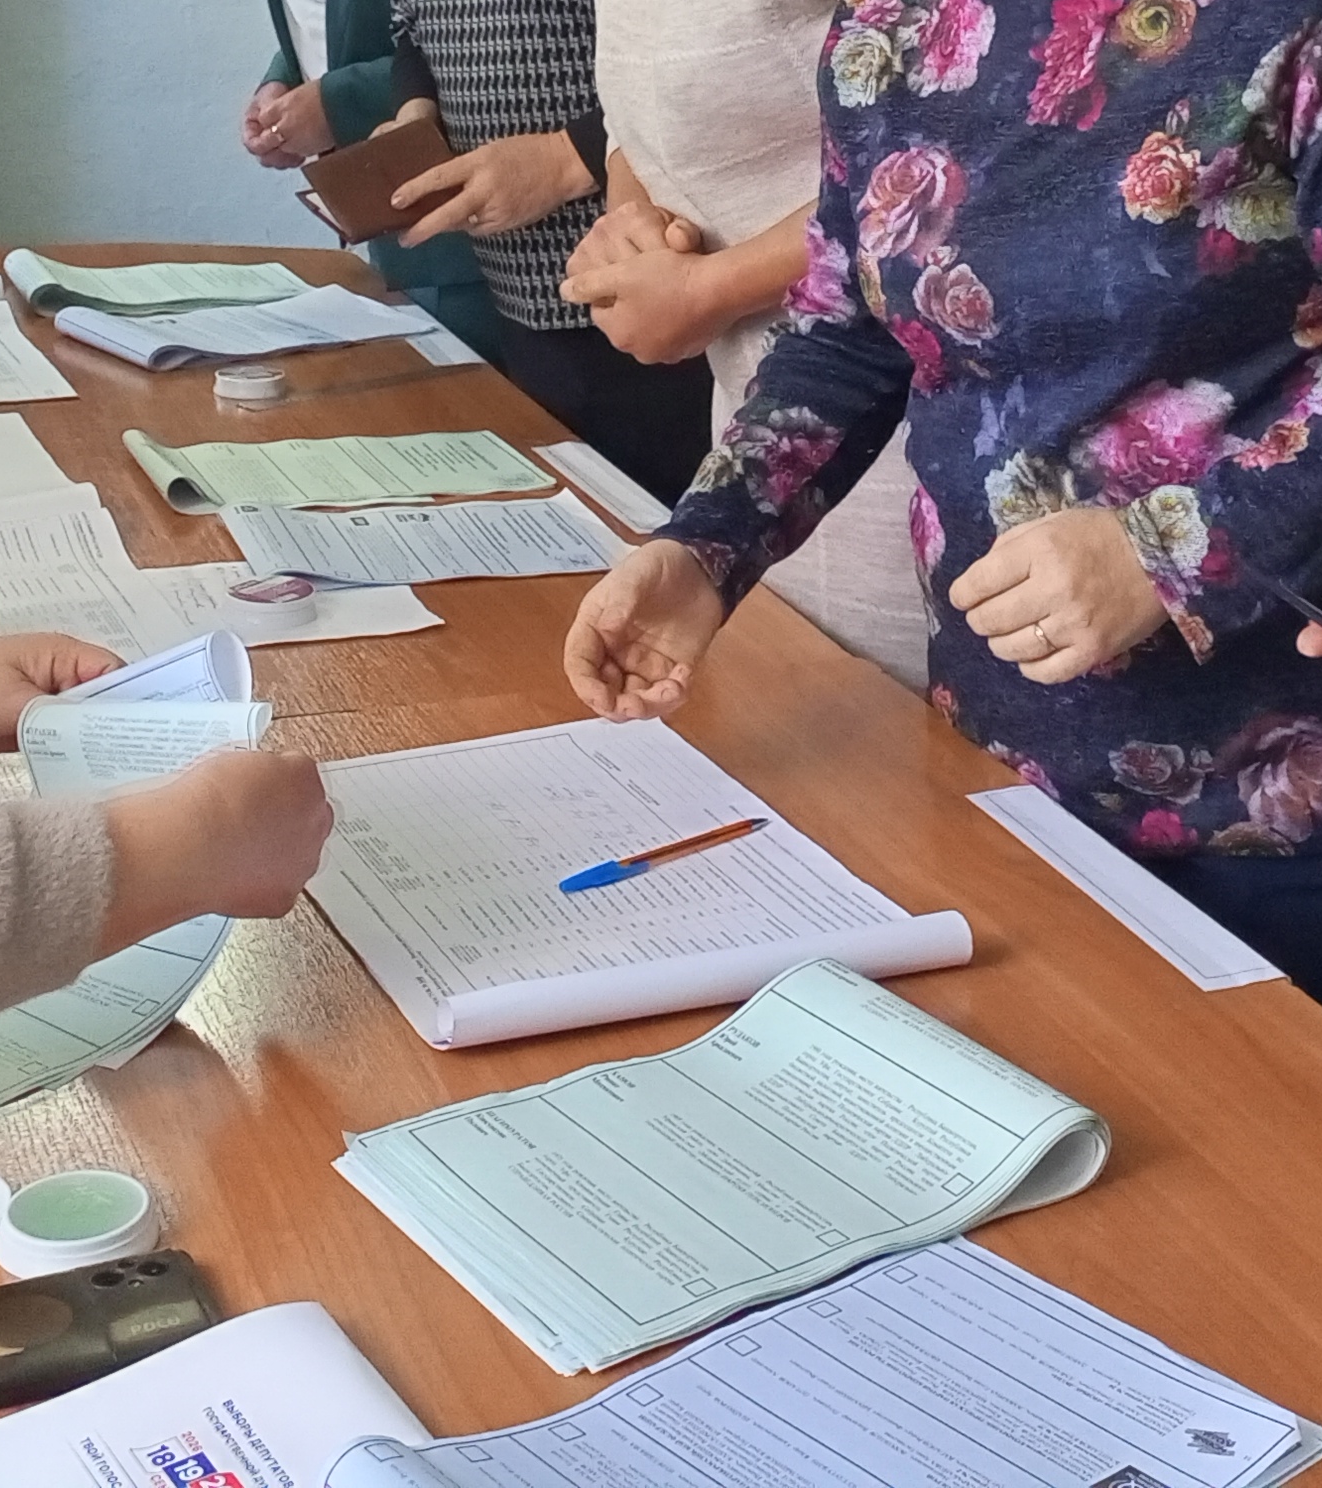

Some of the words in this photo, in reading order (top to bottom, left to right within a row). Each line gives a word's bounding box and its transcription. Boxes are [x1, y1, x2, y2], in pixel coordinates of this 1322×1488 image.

[80, 1437, 104, 1462] ТВОЙ
[181, 1430, 203, 1452] 2026
[203, 1406, 260, 1479] ГОСУДАРСТВЕННОЙ
[222, 1399, 256, 1440] ВЫБОРЫ
[250, 1436, 294, 1488] ДЕПУТАТОВ
[147, 1444, 176, 1466] 18
[174, 1458, 205, 1482] 19
